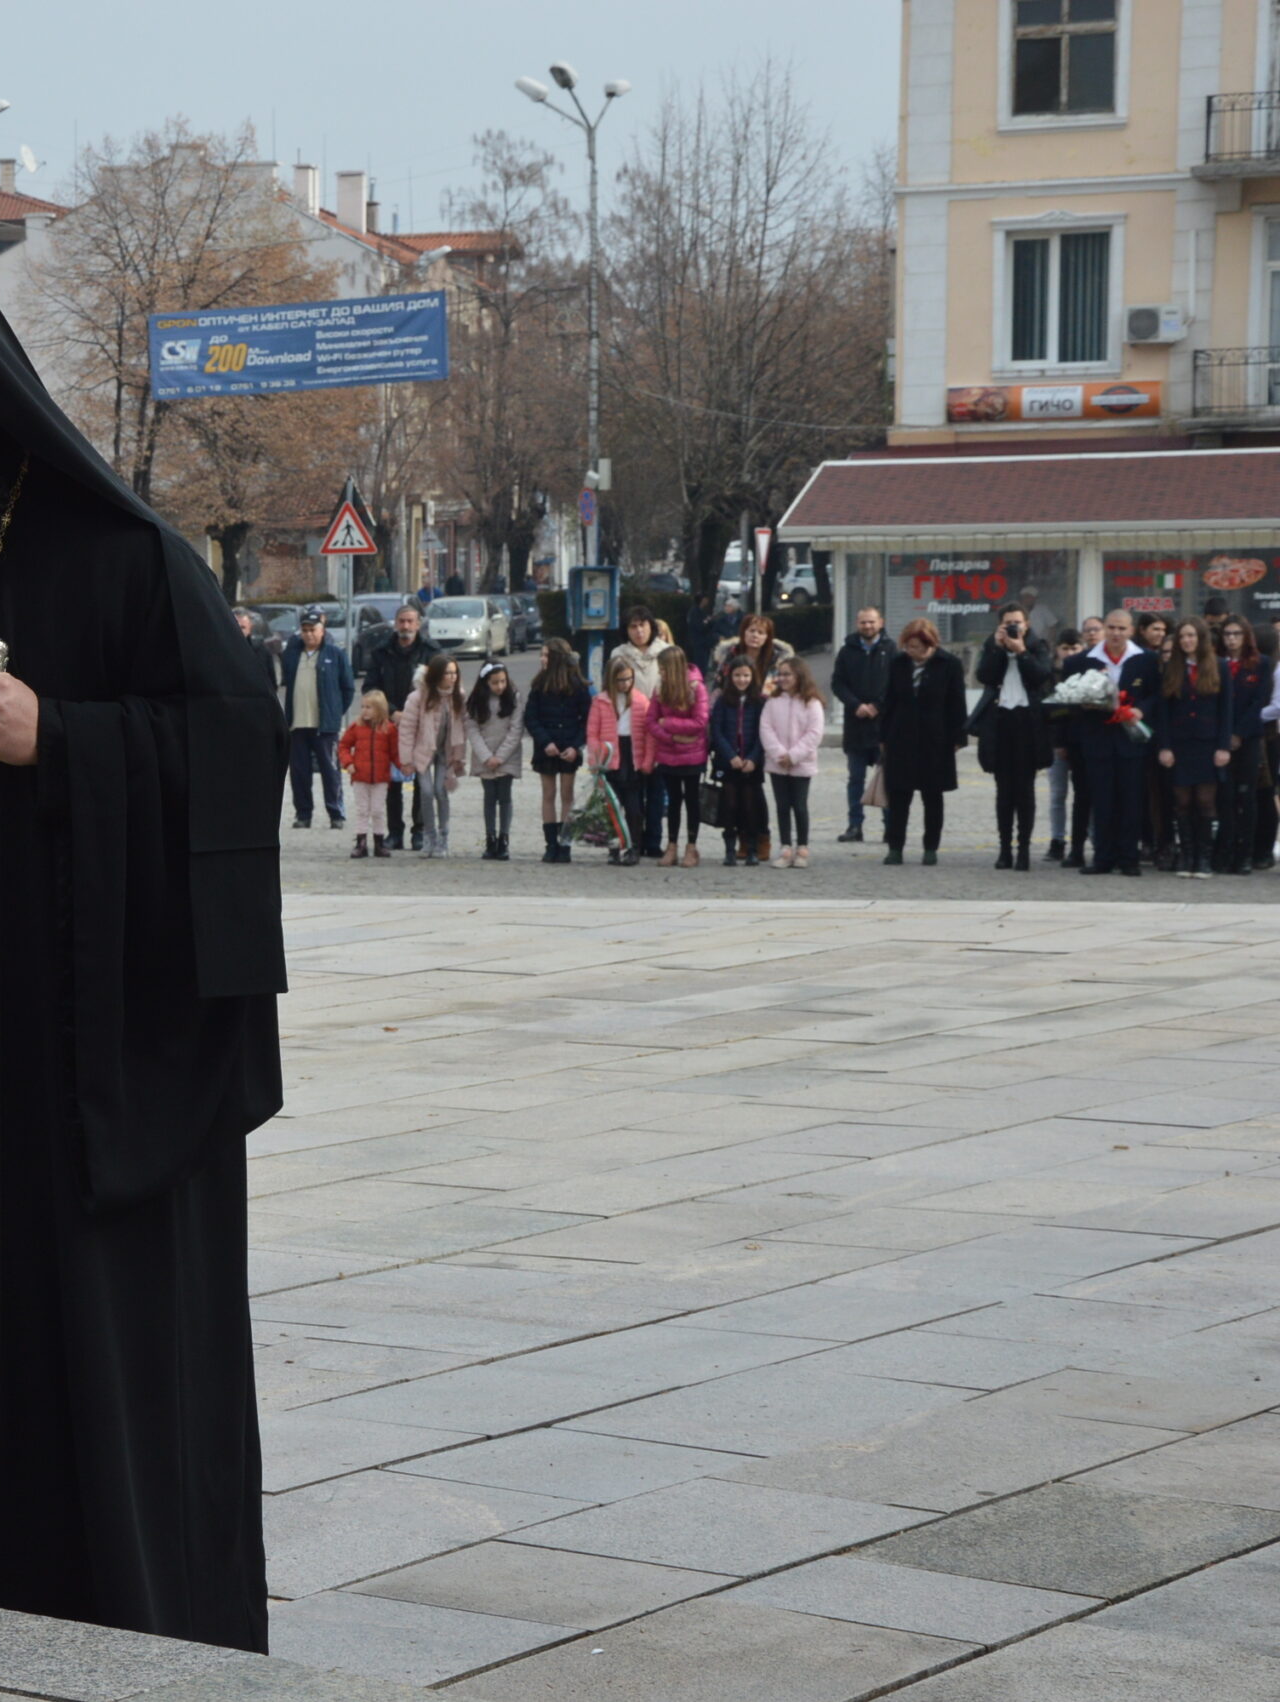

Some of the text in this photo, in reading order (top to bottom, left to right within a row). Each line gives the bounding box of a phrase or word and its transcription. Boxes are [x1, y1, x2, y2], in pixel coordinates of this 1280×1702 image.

[198, 313, 258, 327] ОПТИЧЕН
[260, 308, 328, 322] ИНТЕРНЕТ
[330, 306, 350, 318] ДО
[353, 301, 405, 315] ВАШИЯ
[407, 298, 439, 312] ДОМ
[252, 322, 289, 332] КАБЕЛ
[290, 316, 356, 329] САТ-ЗАПАД
[315, 329, 350, 339] Високи
[204, 343, 248, 373] 200
[246, 349, 312, 366] Download
[929, 558, 990, 572] Пекарна
[913, 573, 1008, 600] ГИЧО
[927, 602, 990, 615] Пицария
[1124, 597, 1175, 611] PIZZA
